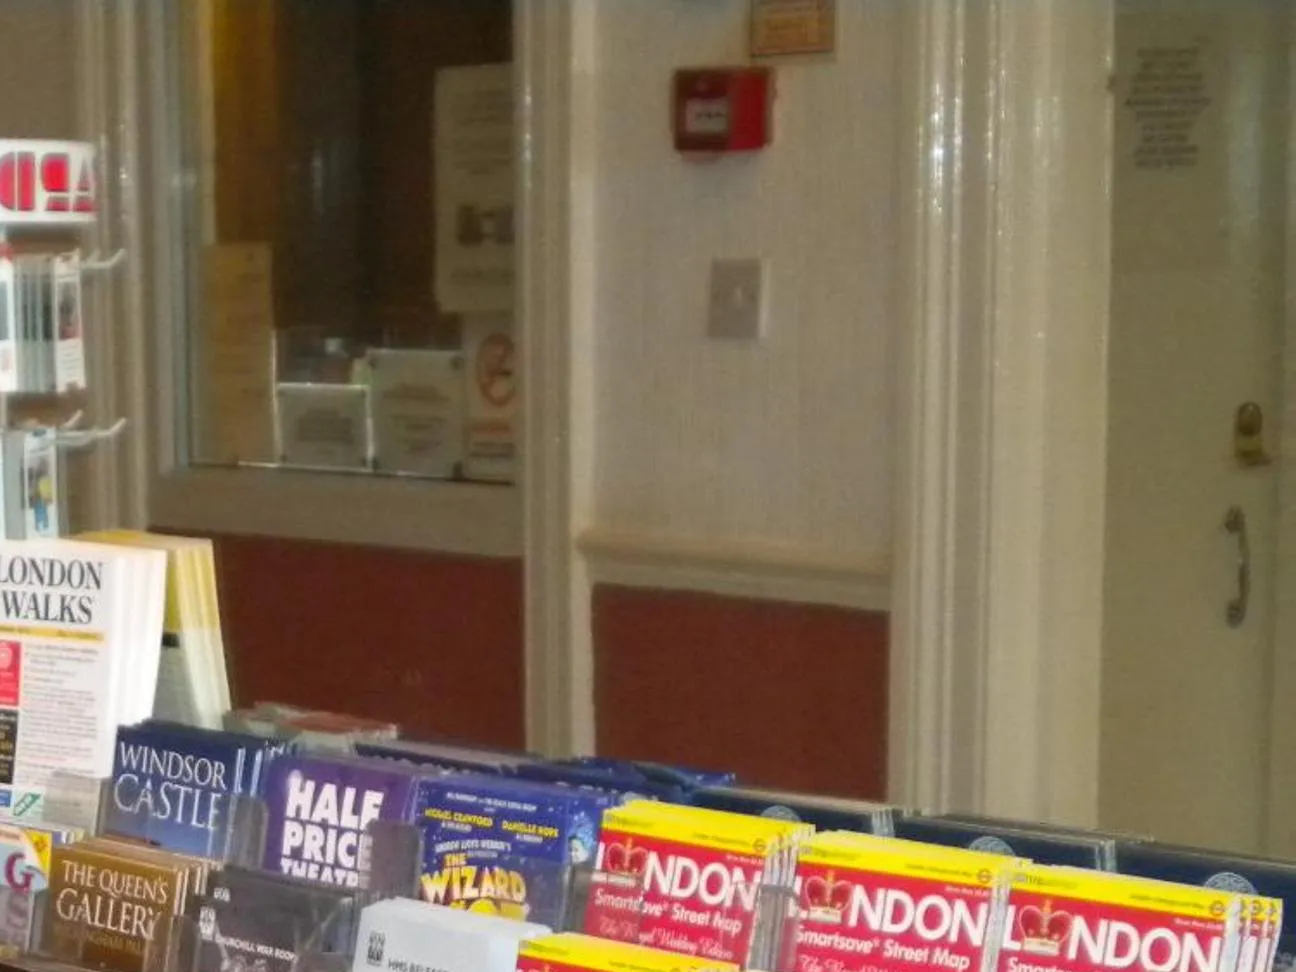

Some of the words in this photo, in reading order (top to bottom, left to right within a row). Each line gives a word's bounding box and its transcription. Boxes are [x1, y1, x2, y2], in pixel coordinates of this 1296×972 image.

[1, 590, 94, 625] WALKS
[119, 741, 228, 791] WINDSOR
[113, 773, 223, 830] CASTLE
[286, 774, 385, 831] HALF
[62, 859, 95, 889] THE
[98, 868, 169, 905] QUEEN'S
[420, 864, 527, 905] WIZARD
[55, 887, 162, 941] GALLERY
[671, 902, 710, 929] Street
[883, 938, 929, 964] Street
[932, 946, 970, 972] Map
